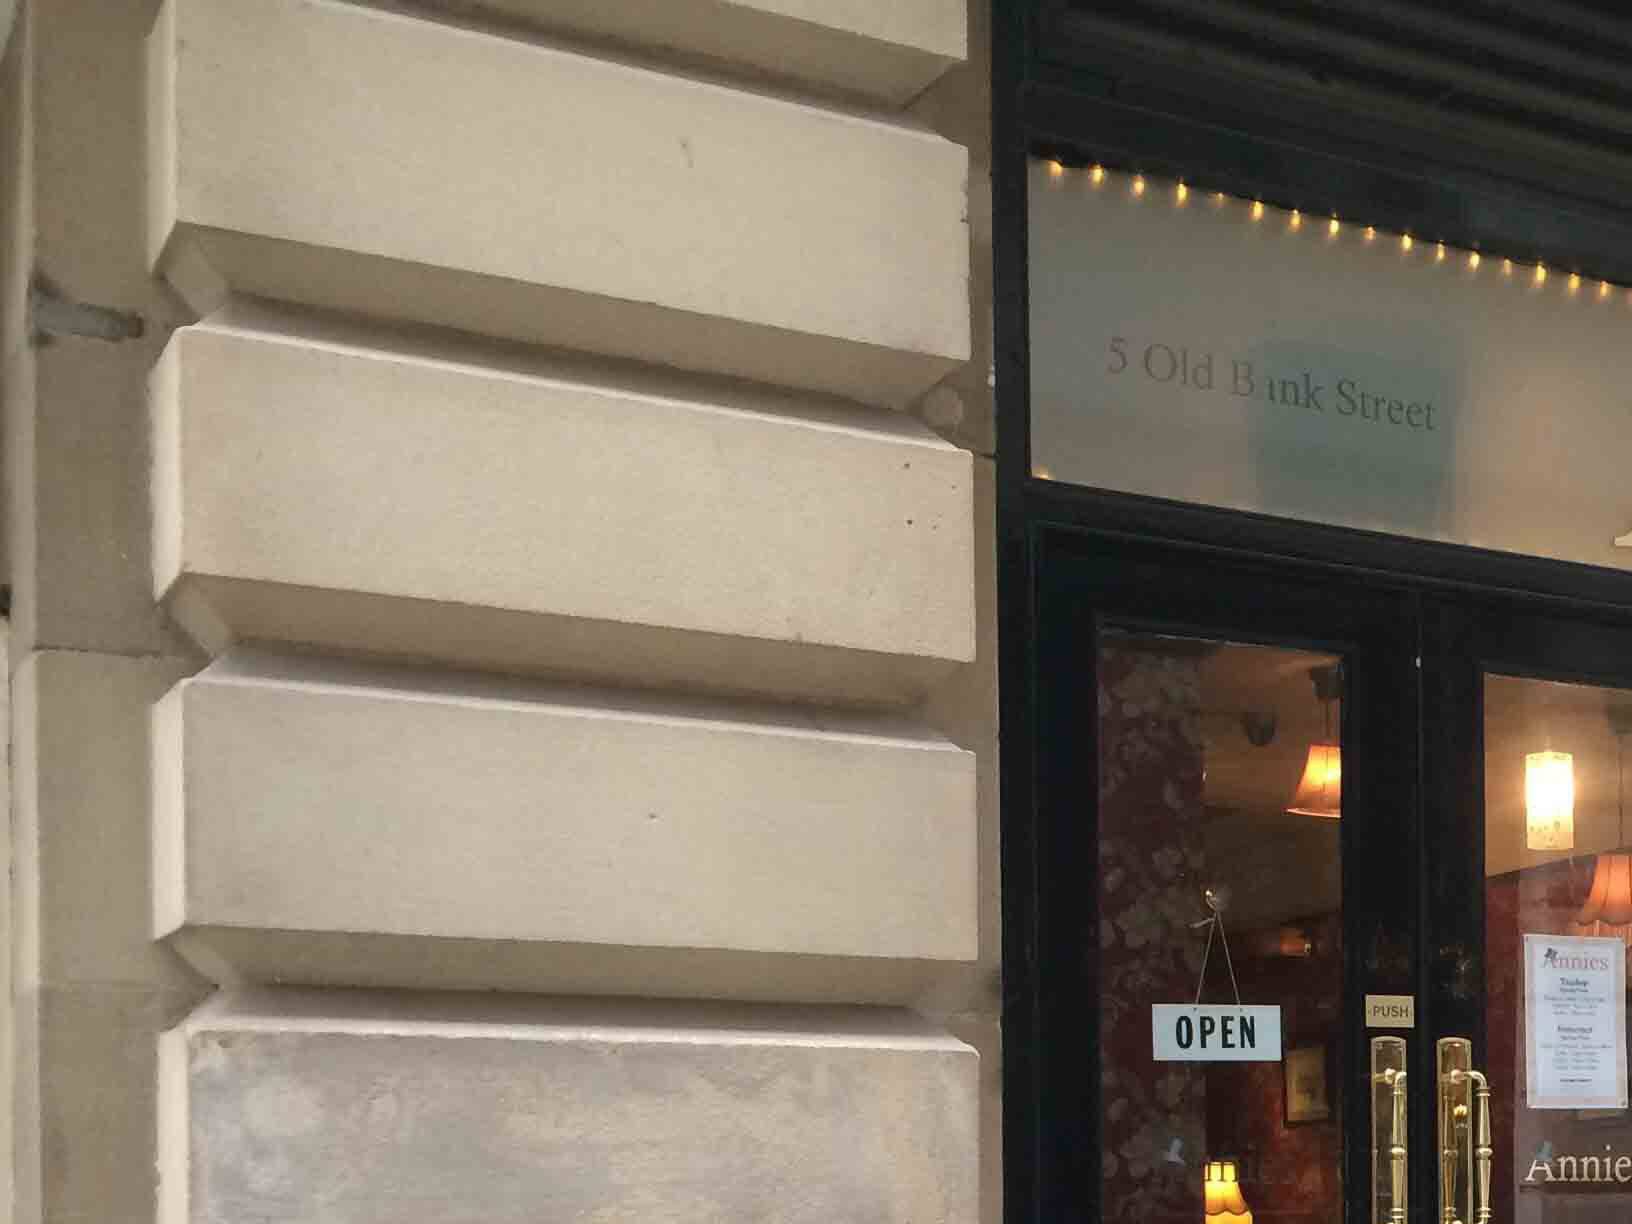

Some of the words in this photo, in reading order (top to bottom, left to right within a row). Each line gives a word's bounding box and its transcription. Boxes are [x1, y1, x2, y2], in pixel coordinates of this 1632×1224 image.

[1106, 336, 1128, 375] 5
[1143, 342, 1215, 392] Old
[1336, 378, 1437, 432] Street
[1372, 1005, 1409, 1018] PUSH
[1175, 1014, 1257, 1050] OPEN
